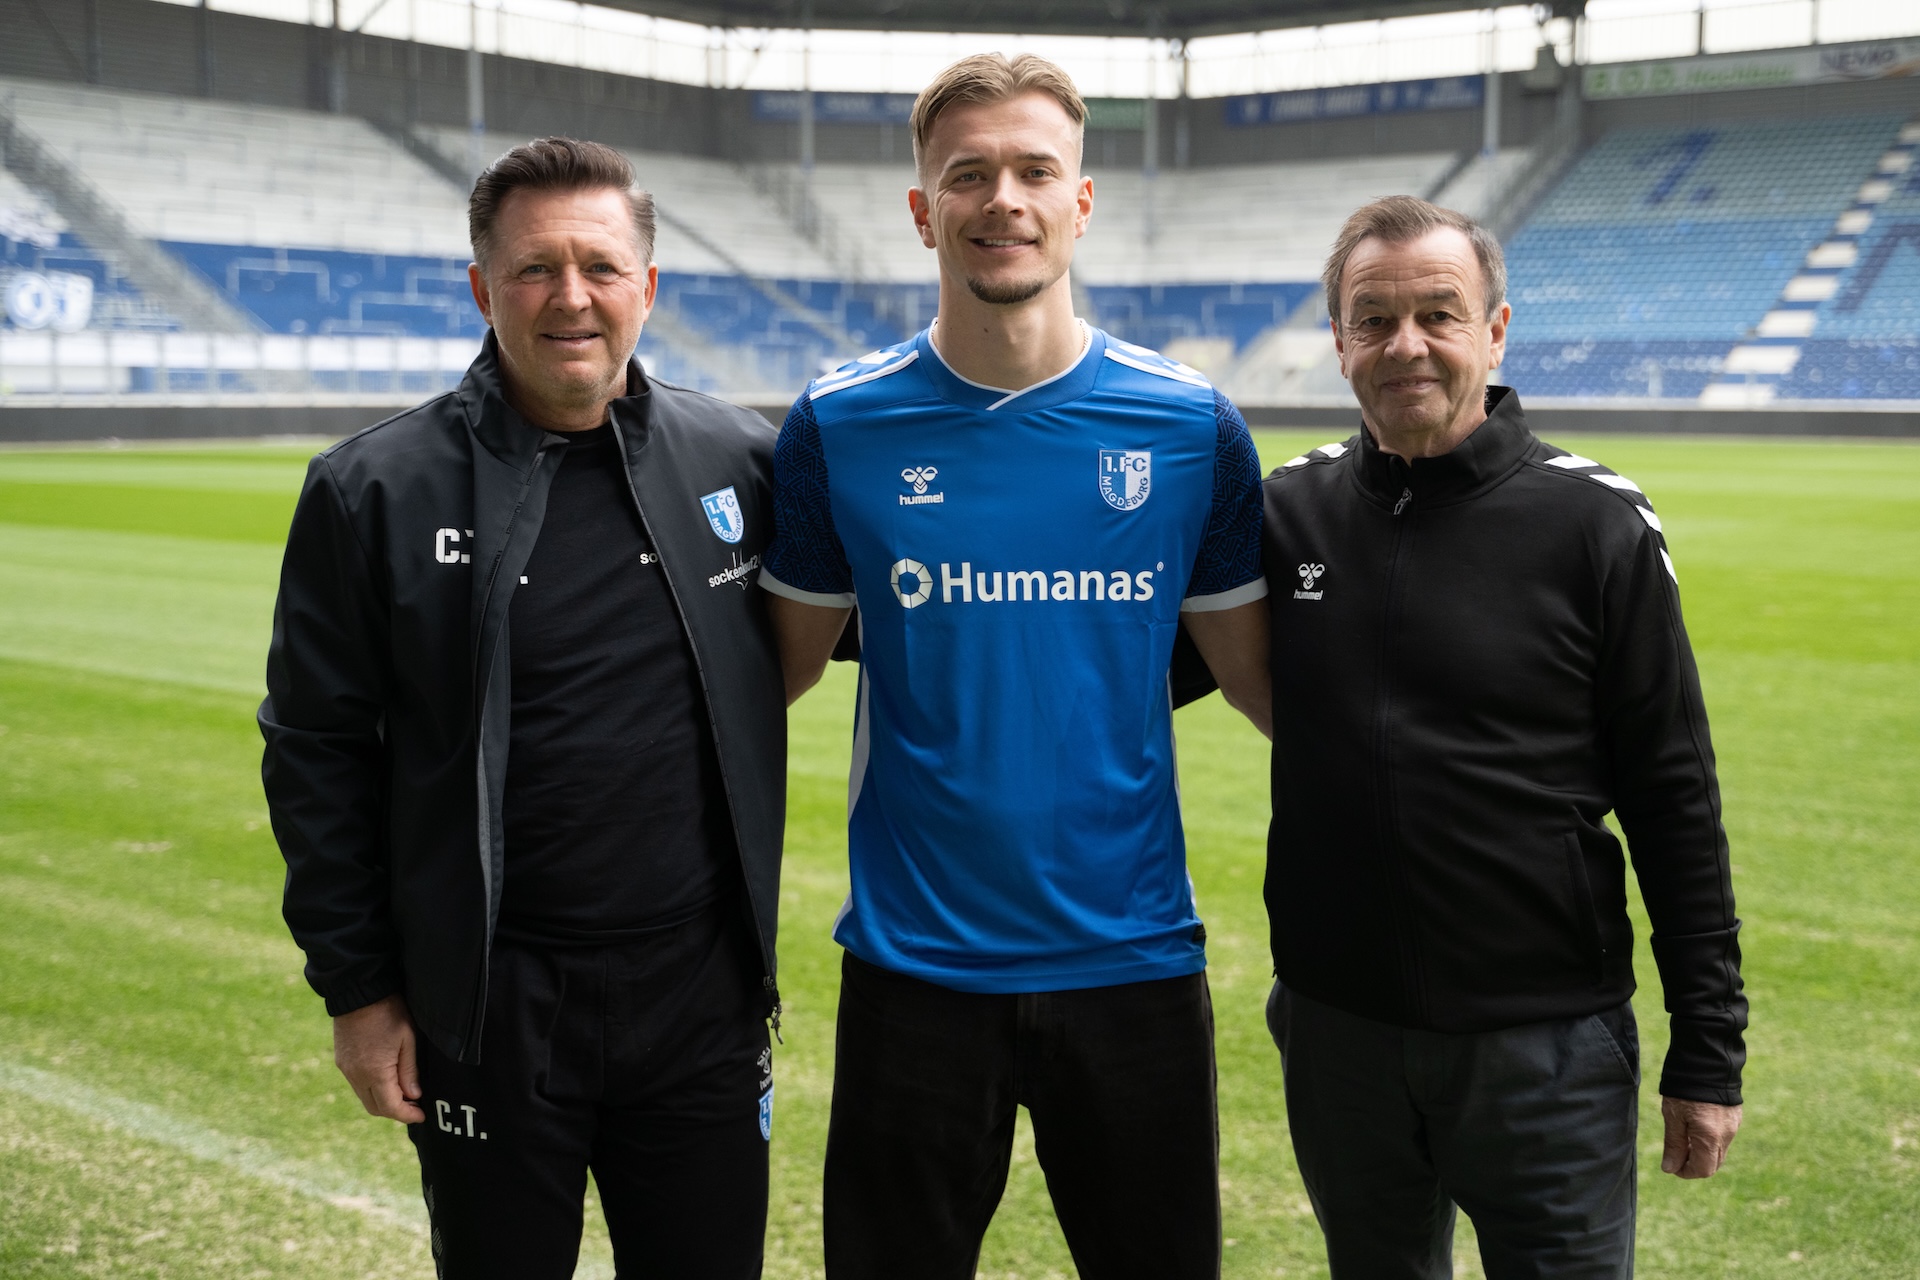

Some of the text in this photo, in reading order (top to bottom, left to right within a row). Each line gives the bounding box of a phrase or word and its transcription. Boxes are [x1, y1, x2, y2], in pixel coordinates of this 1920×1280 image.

[899, 491, 944, 506] hummel
[1101, 476, 1149, 507] MAGDEBURG
[1293, 588, 1324, 601] hummel
[435, 1099, 488, 1141] C.T.
